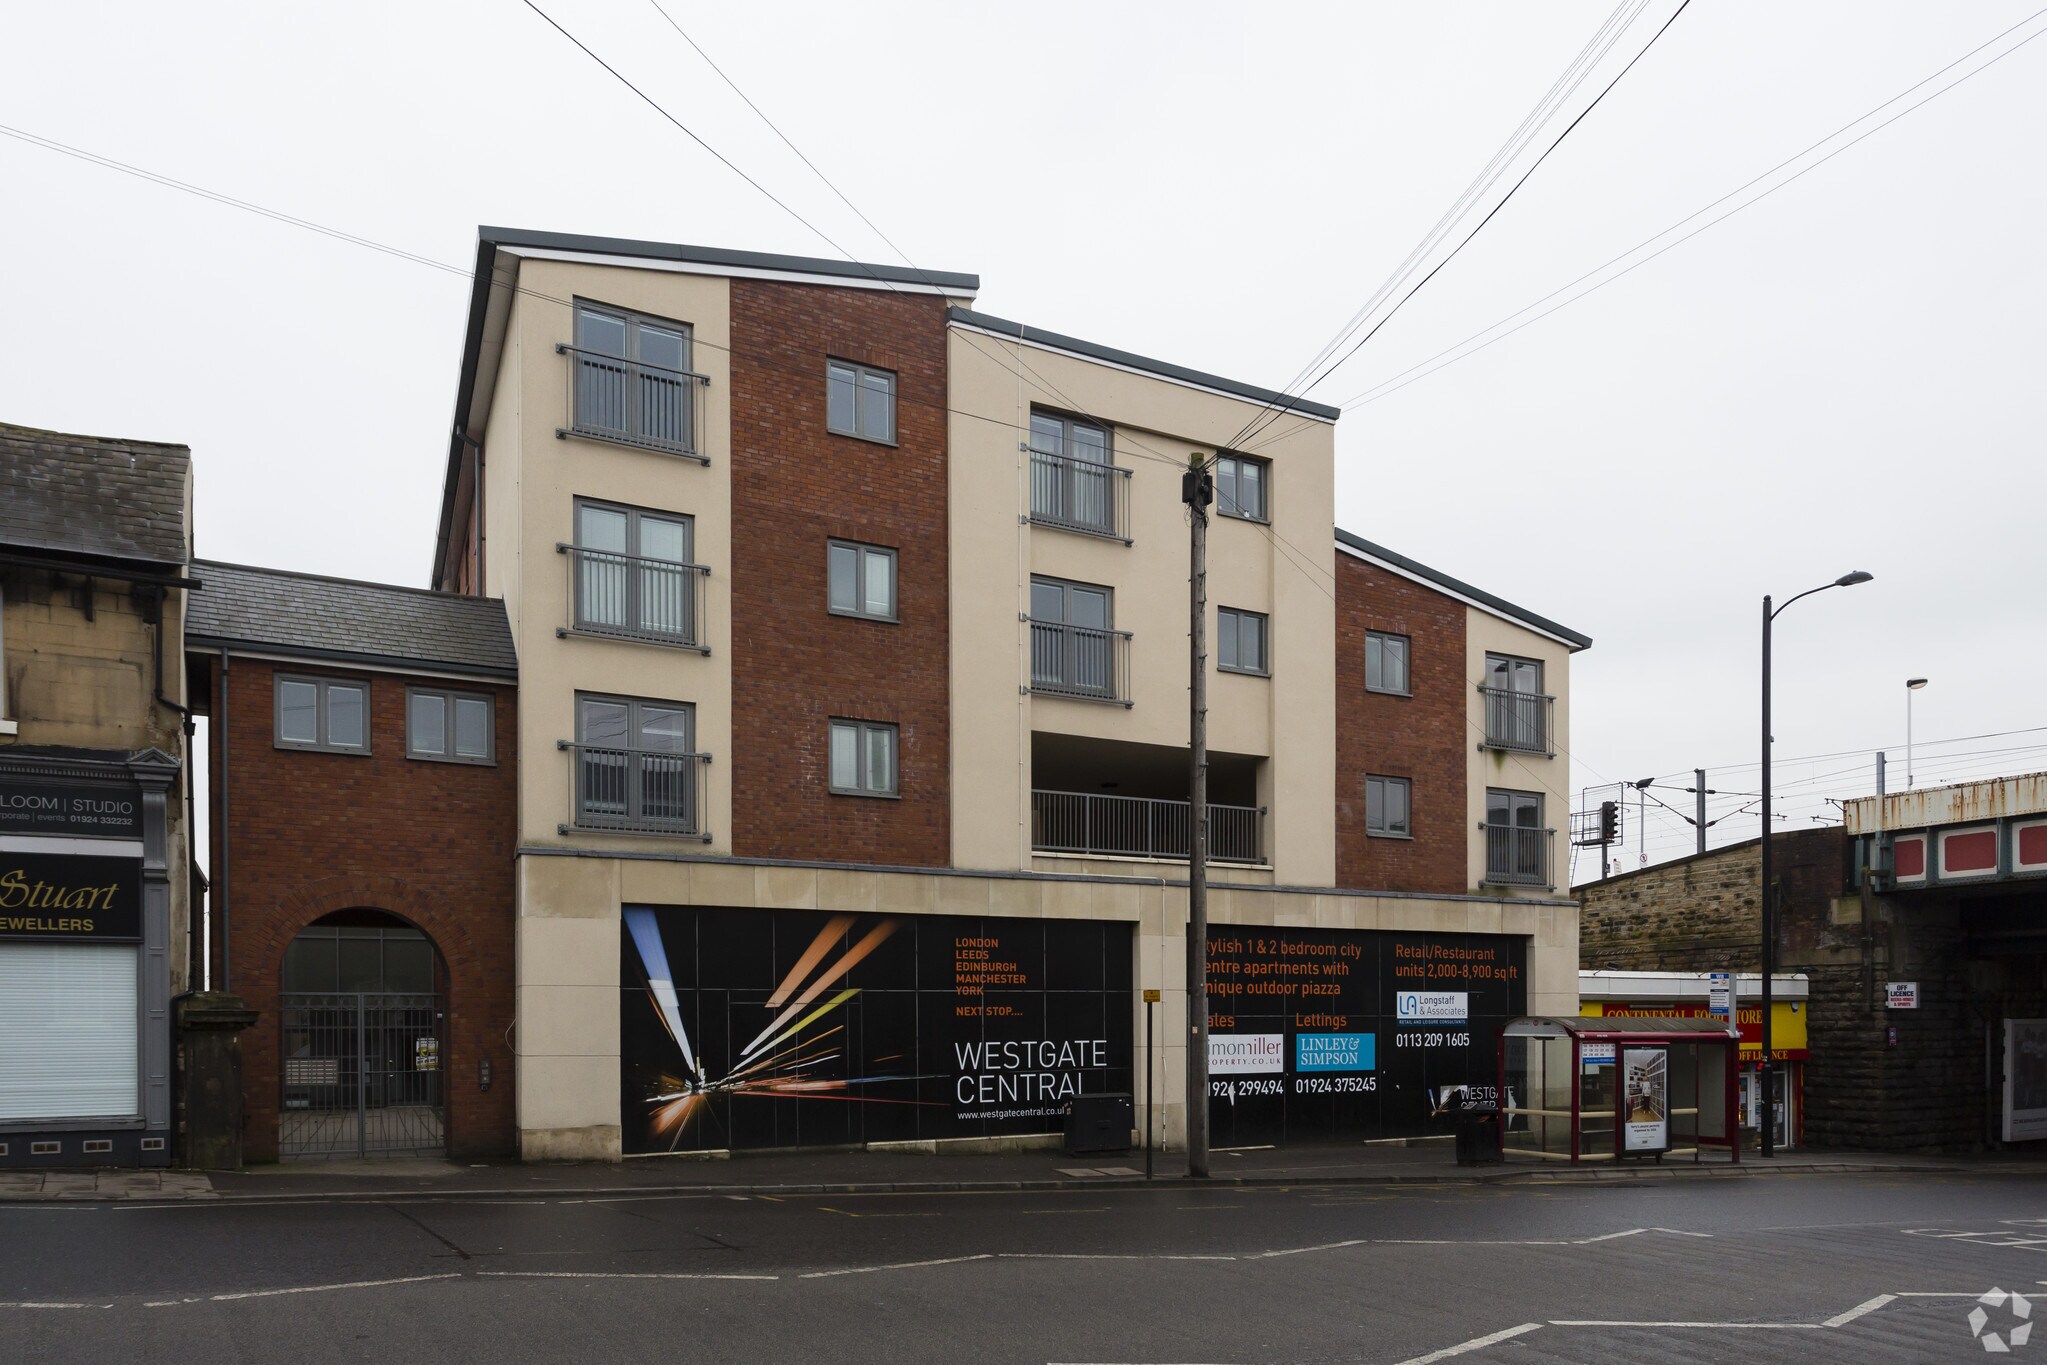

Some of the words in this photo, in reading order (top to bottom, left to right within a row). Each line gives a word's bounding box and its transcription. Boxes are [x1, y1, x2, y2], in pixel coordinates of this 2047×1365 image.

[0, 795, 58, 809] LOOM
[73, 799, 132, 814] STUDIO
[38, 814, 66, 822] events
[70, 815, 97, 824] 01924
[100, 816, 133, 825] 332232
[0, 869, 119, 910] Stuart
[0, 917, 94, 931] EWELLERS
[955, 938, 999, 948] LONDON
[1206, 938, 1243, 957] tylish
[1247, 939, 1253, 953] 1
[1256, 939, 1267, 954] &
[1269, 940, 1277, 954] 2
[1280, 940, 1337, 956] bedroom
[1340, 942, 1362, 960] city
[955, 950, 990, 960] LEEDS
[1395, 944, 1495, 960] Retail/Restaurant
[955, 962, 1017, 972] EDINBURGH
[1206, 960, 1241, 973] entre
[1243, 960, 1320, 977] apartments
[1322, 961, 1349, 975] with
[1396, 963, 1424, 977] units
[1427, 964, 1491, 980] 2,000-8,900
[1494, 967, 1506, 982] sq
[1509, 965, 1518, 979] ft
[956, 974, 1027, 984] MANCHESTER
[956, 986, 984, 996] YORK
[1206, 979, 1243, 998] nique
[1246, 980, 1298, 995] outdoor
[1301, 981, 1341, 998] piazza
[1419, 995, 1455, 1007] Longstaff
[956, 1007, 983, 1016] NEXT
[1419, 1006, 1425, 1015] &
[1427, 1006, 1466, 1016] Associates
[1736, 1009, 1762, 1024] TORE
[1208, 1012, 1235, 1028] ales
[1296, 1012, 1347, 1030] Lettings
[1396, 1033, 1422, 1047] 0113
[1424, 1033, 1443, 1047] 209
[1446, 1033, 1470, 1047] 1605
[955, 1040, 1108, 1070] WESTGATE
[1208, 1057, 1281, 1066] OPERTY.CO.UK
[1301, 1052, 1358, 1065] SIMPSON
[1752, 1051, 1788, 1061] LINCE
[1238, 1080, 1284, 1096] 299494
[1296, 1078, 1332, 1094] 01924
[1334, 1077, 1377, 1092] 375245
[1460, 1086, 1514, 1100] WESTGTE
